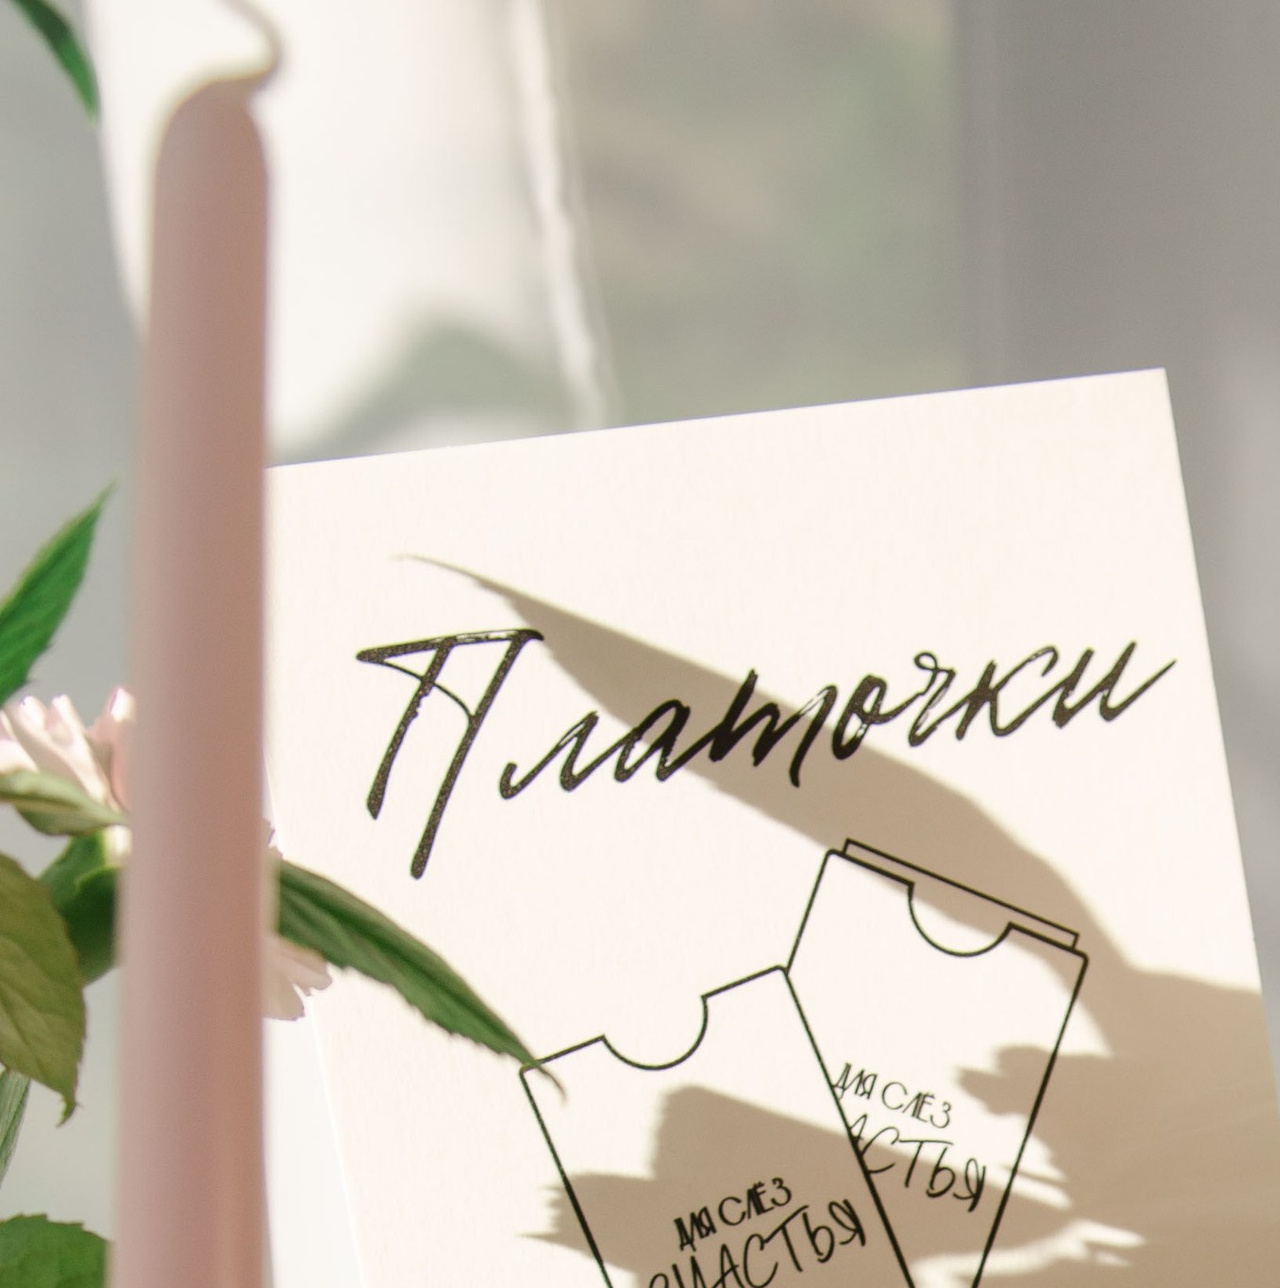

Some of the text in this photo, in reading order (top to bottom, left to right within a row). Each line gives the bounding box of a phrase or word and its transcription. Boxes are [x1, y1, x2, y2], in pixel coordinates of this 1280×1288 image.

[356, 627, 1176, 879] Платочки
[718, 1177, 792, 1226] СЛЁЗ
[849, 1113, 986, 1213] АСТЬЯ
